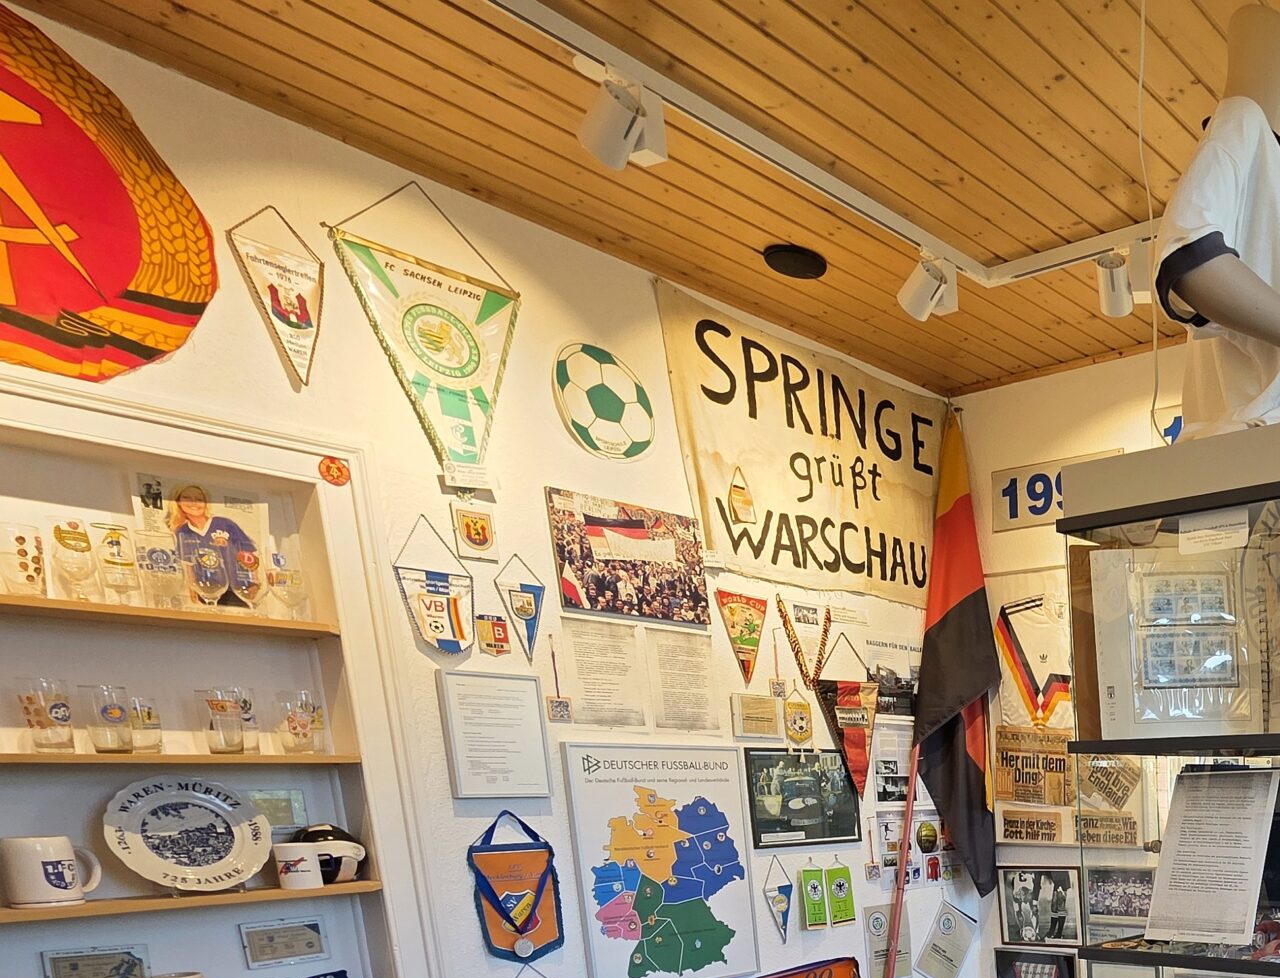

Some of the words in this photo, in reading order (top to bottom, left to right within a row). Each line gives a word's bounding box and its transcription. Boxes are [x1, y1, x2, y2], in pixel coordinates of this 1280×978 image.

[384, 261, 396, 273] FC
[402, 268, 444, 289] SACHSEN
[447, 283, 482, 302] LEIPZIG
[693, 318, 935, 476] SPRINGE
[788, 452, 883, 510] grüßt
[715, 496, 928, 589] WARSCHAU
[421, 598, 445, 613] VB
[750, 599, 766, 612] CUP
[494, 626, 505, 639] B
[603, 759, 660, 770] DEUTSCHER
[661, 760, 729, 771] FUSSBALL-BUND
[1001, 750, 1020, 769] Her
[1021, 752, 1040, 771] mit
[1042, 753, 1066, 773] dem
[1014, 767, 1038, 785] Ding
[1113, 771, 1131, 797] bye
[118, 782, 166, 813] WAREN
[176, 781, 242, 810] MÜRITZ
[1025, 829, 1041, 841] hilf
[1041, 829, 1057, 842] mir
[1102, 831, 1124, 844] diese
[1124, 831, 1138, 845] Elf
[162, 872, 188, 885] 725
[195, 866, 244, 885] JAHRE
